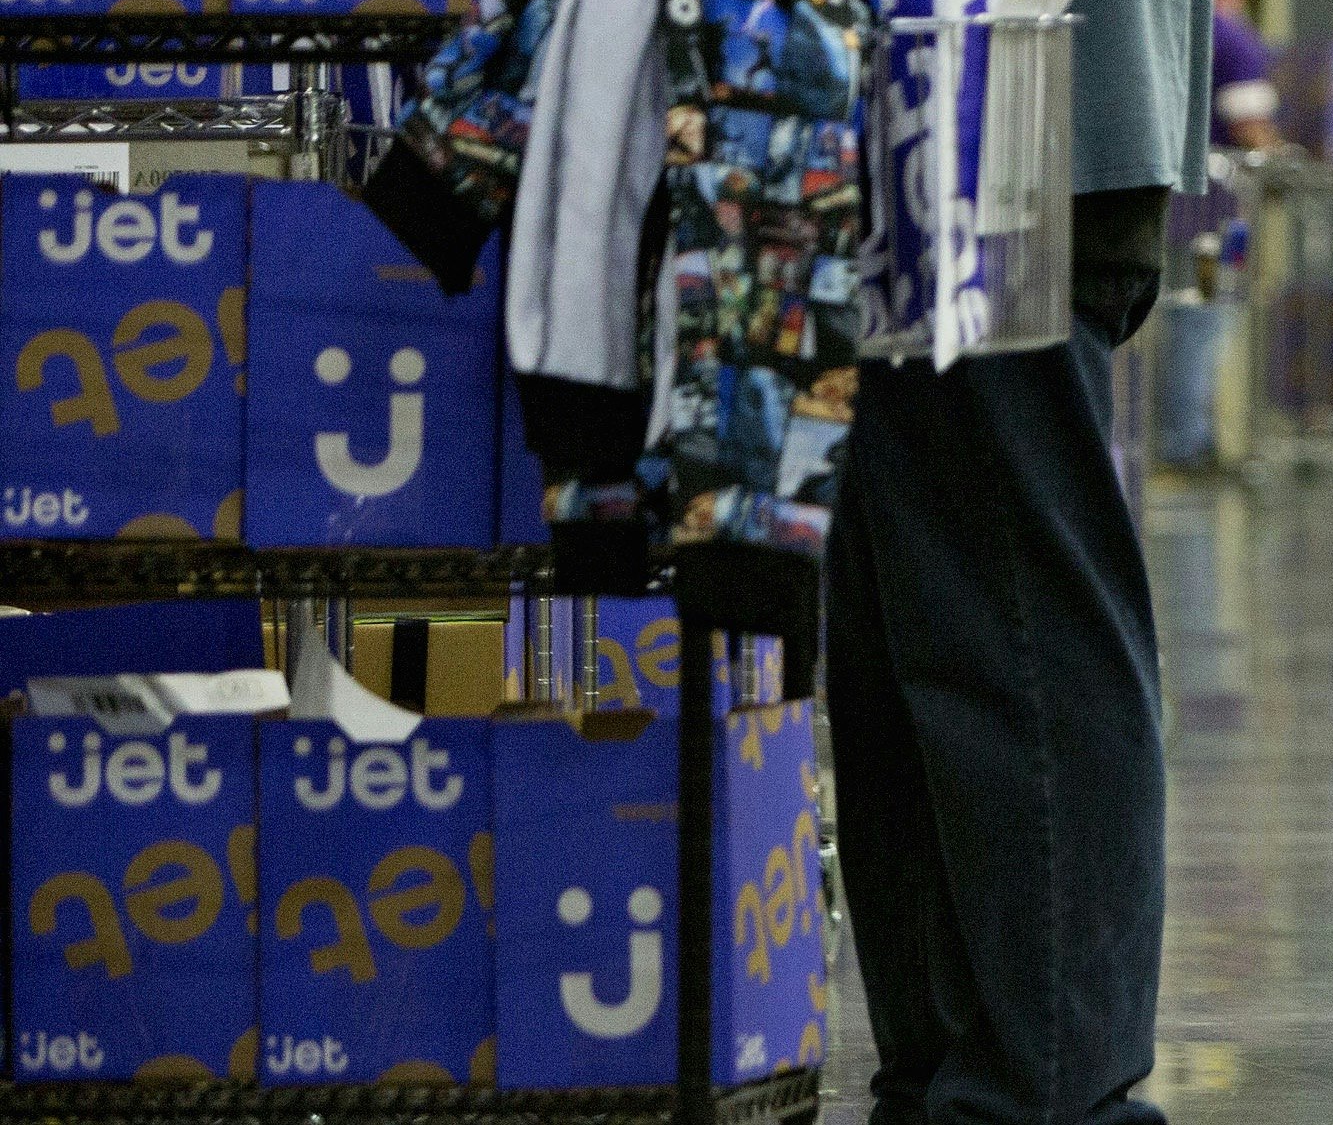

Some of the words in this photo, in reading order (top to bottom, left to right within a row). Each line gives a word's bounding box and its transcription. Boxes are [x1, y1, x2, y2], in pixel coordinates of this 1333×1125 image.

[39, 190, 213, 264] jet
[4, 488, 90, 526] jet
[49, 732, 222, 806] jet
[295, 737, 464, 811] jet
[20, 1032, 104, 1071] jet
[267, 1036, 349, 1072] jet
